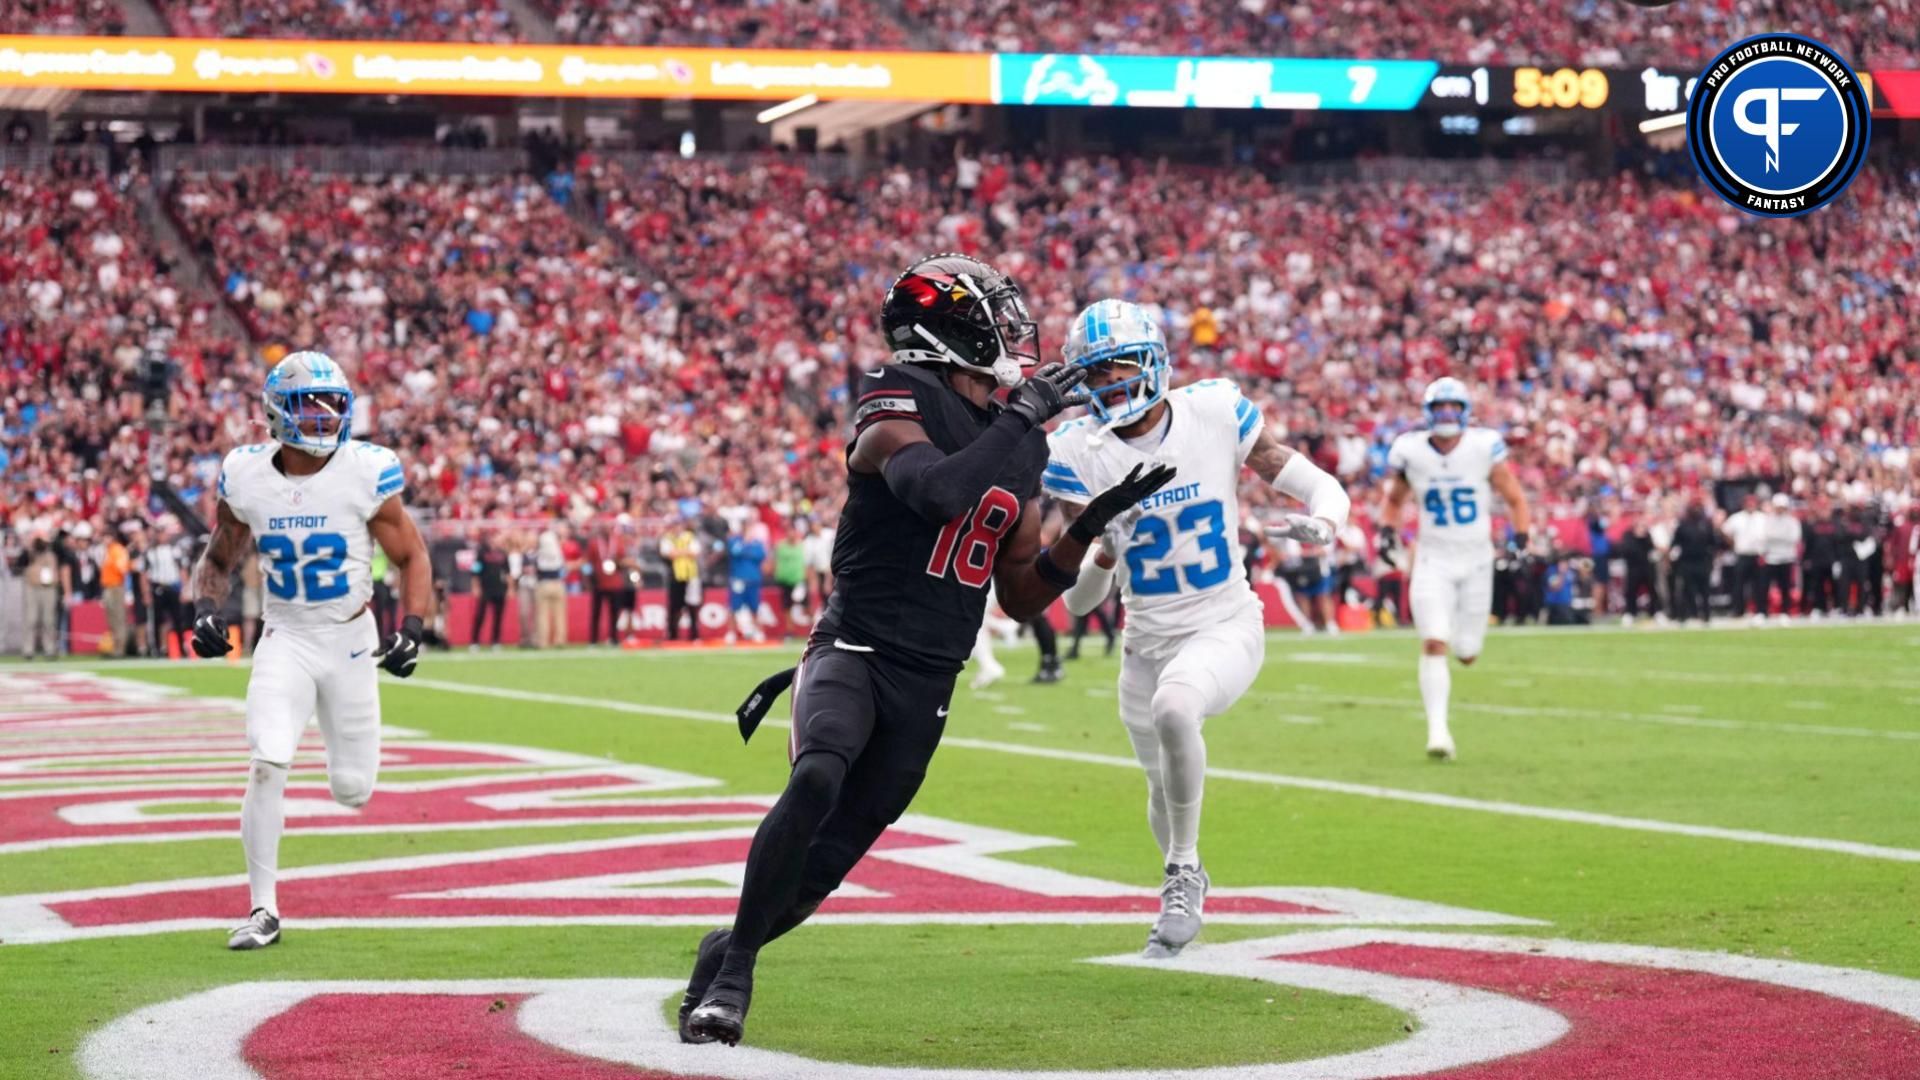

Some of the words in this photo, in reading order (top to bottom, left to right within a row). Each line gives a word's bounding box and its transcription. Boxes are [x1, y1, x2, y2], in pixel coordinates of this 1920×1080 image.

[1347, 66, 1377, 102] 7
[1513, 67, 1609, 109] 5:09
[1141, 482, 1200, 510] ETROIT
[1424, 488, 1477, 525] 46
[268, 515, 328, 530] DETROIT
[926, 485, 1020, 589] 18
[258, 532, 350, 602] 32
[1125, 499, 1231, 596] 23
